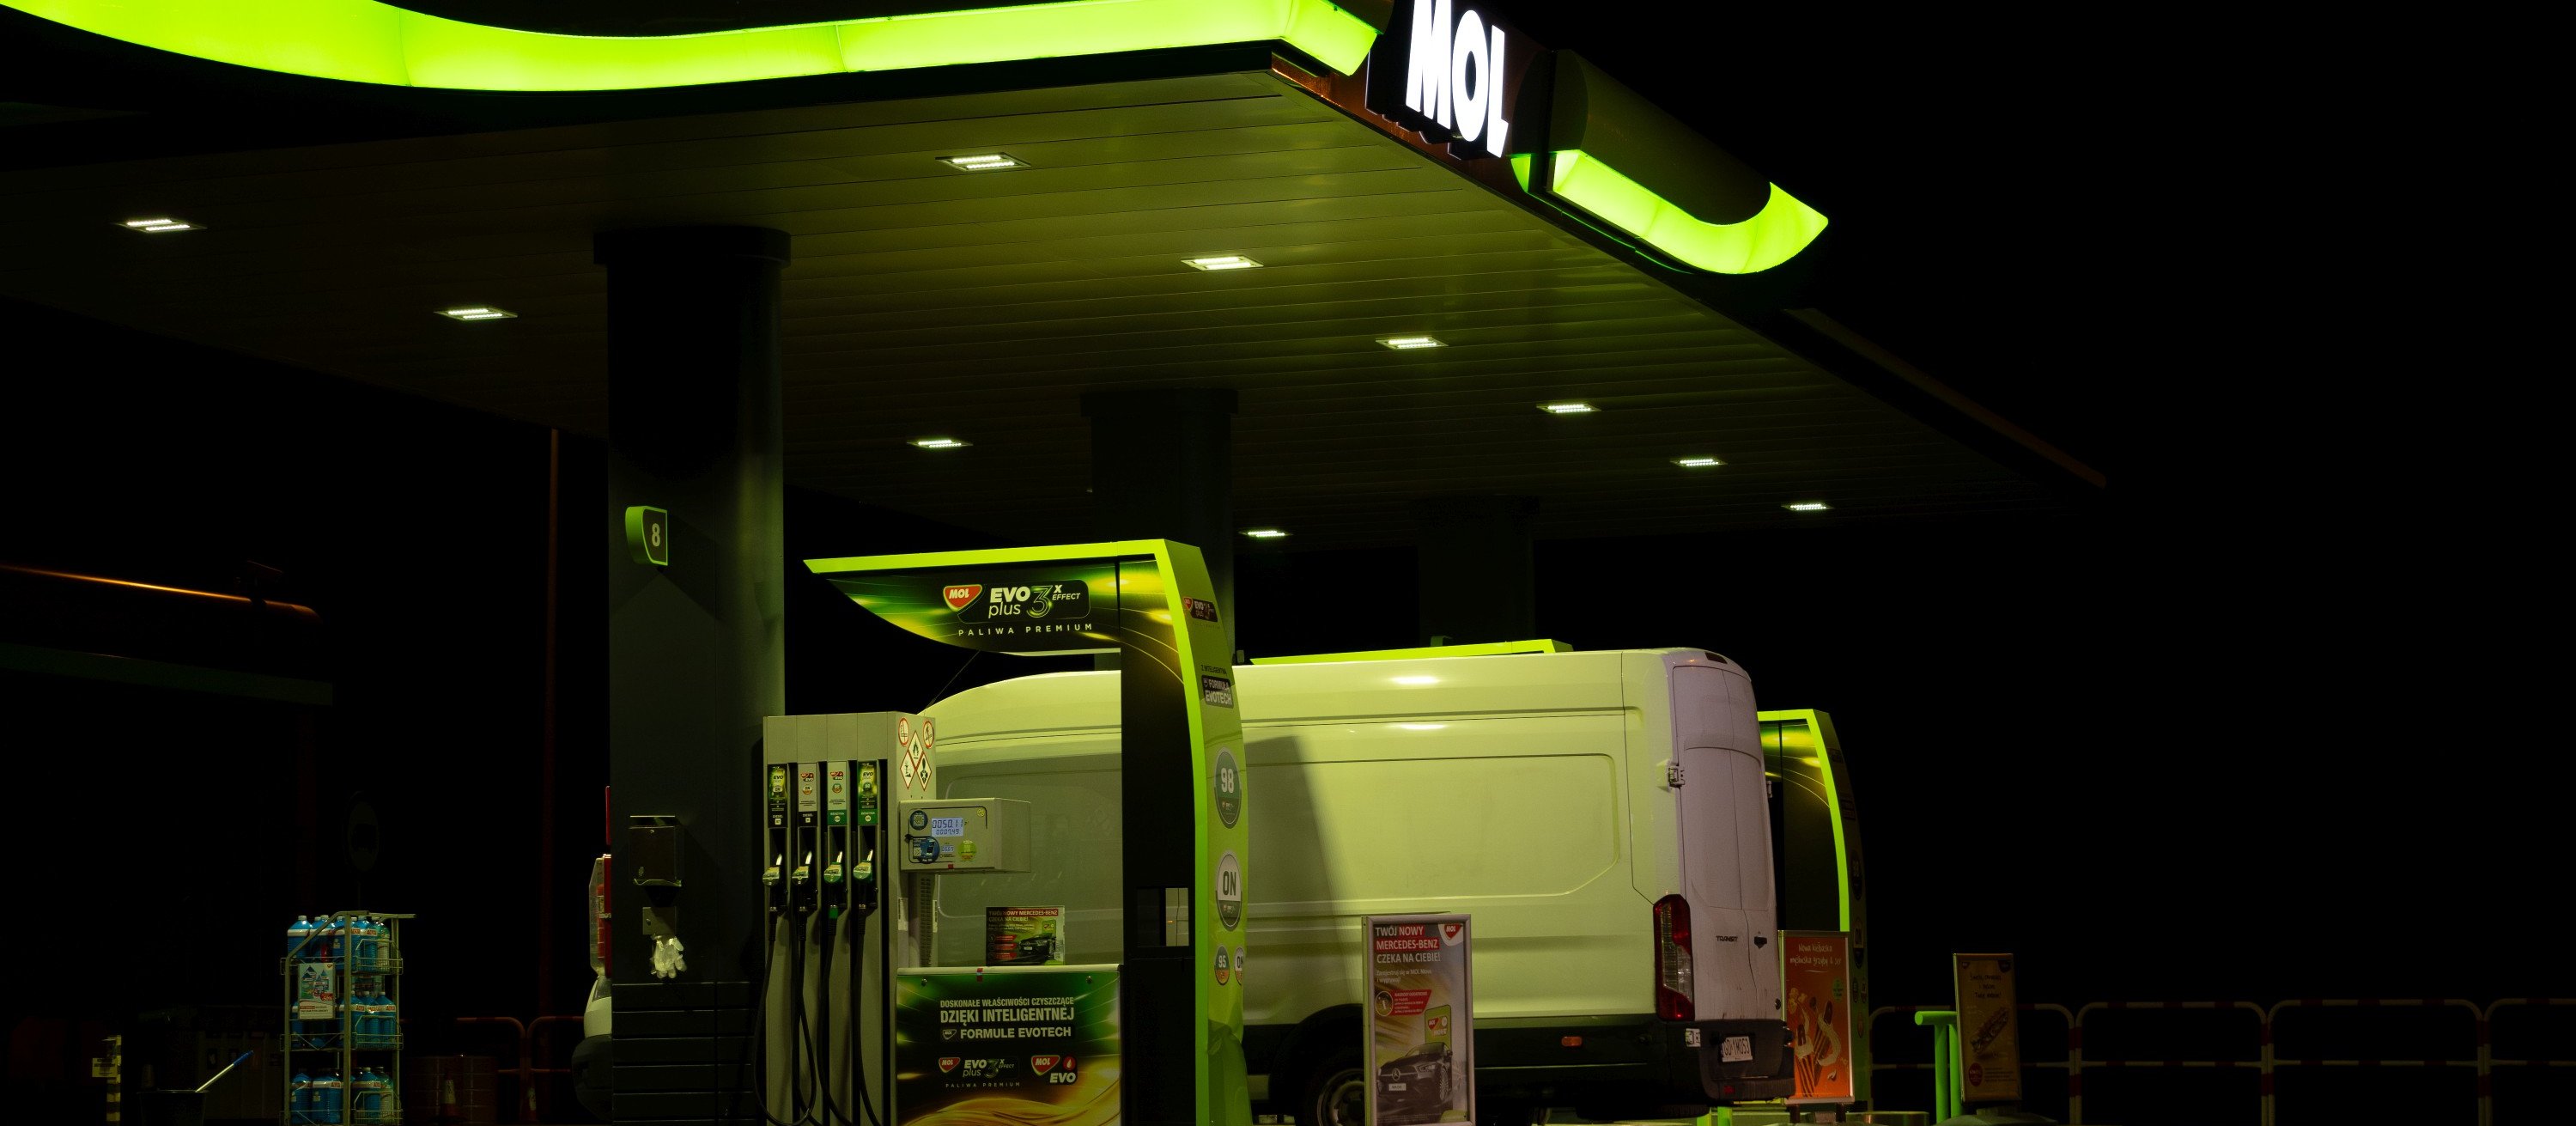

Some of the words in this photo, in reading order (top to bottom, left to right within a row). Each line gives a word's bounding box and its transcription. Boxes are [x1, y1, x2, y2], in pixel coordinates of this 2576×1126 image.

[1406, 0, 1509, 158] MOL
[652, 523, 660, 546] 8
[949, 588, 970, 599] MOL
[990, 586, 1031, 603] EVO
[1026, 585, 1053, 618] 3
[988, 602, 1021, 618] plus
[958, 628, 1014, 636] PALIWA
[1025, 623, 1092, 634] PREMIUM
[1205, 690, 1232, 705] EVOTECH
[1221, 767, 1234, 793] 98
[1223, 870, 1236, 896] ON
[1376, 926, 1396, 936] TWÓJ
[1399, 926, 1424, 935] NOWY
[1376, 939, 1438, 950] MERCEDES-BENZ
[1218, 955, 1226, 968] 95
[1376, 953, 1401, 963] CZEKA
[1403, 953, 1414, 962] NA
[1416, 952, 1441, 962] CIEBIE!
[981, 997, 1030, 1007] WŁAŚCIWOŚCI
[1031, 997, 1074, 1007] CZYSZCZĄCE
[940, 1009, 979, 1026] DZIĘKI
[982, 1007, 1074, 1022] INTELIGENTNEJ
[960, 1029, 1015, 1039] FORMULE
[1018, 1027, 1072, 1038] EVOTECH
[963, 1059, 987, 1069] EVO
[1035, 1057, 1051, 1066] MOL
[962, 1068, 981, 1078] plus
[1049, 1072, 1077, 1083] EVO
